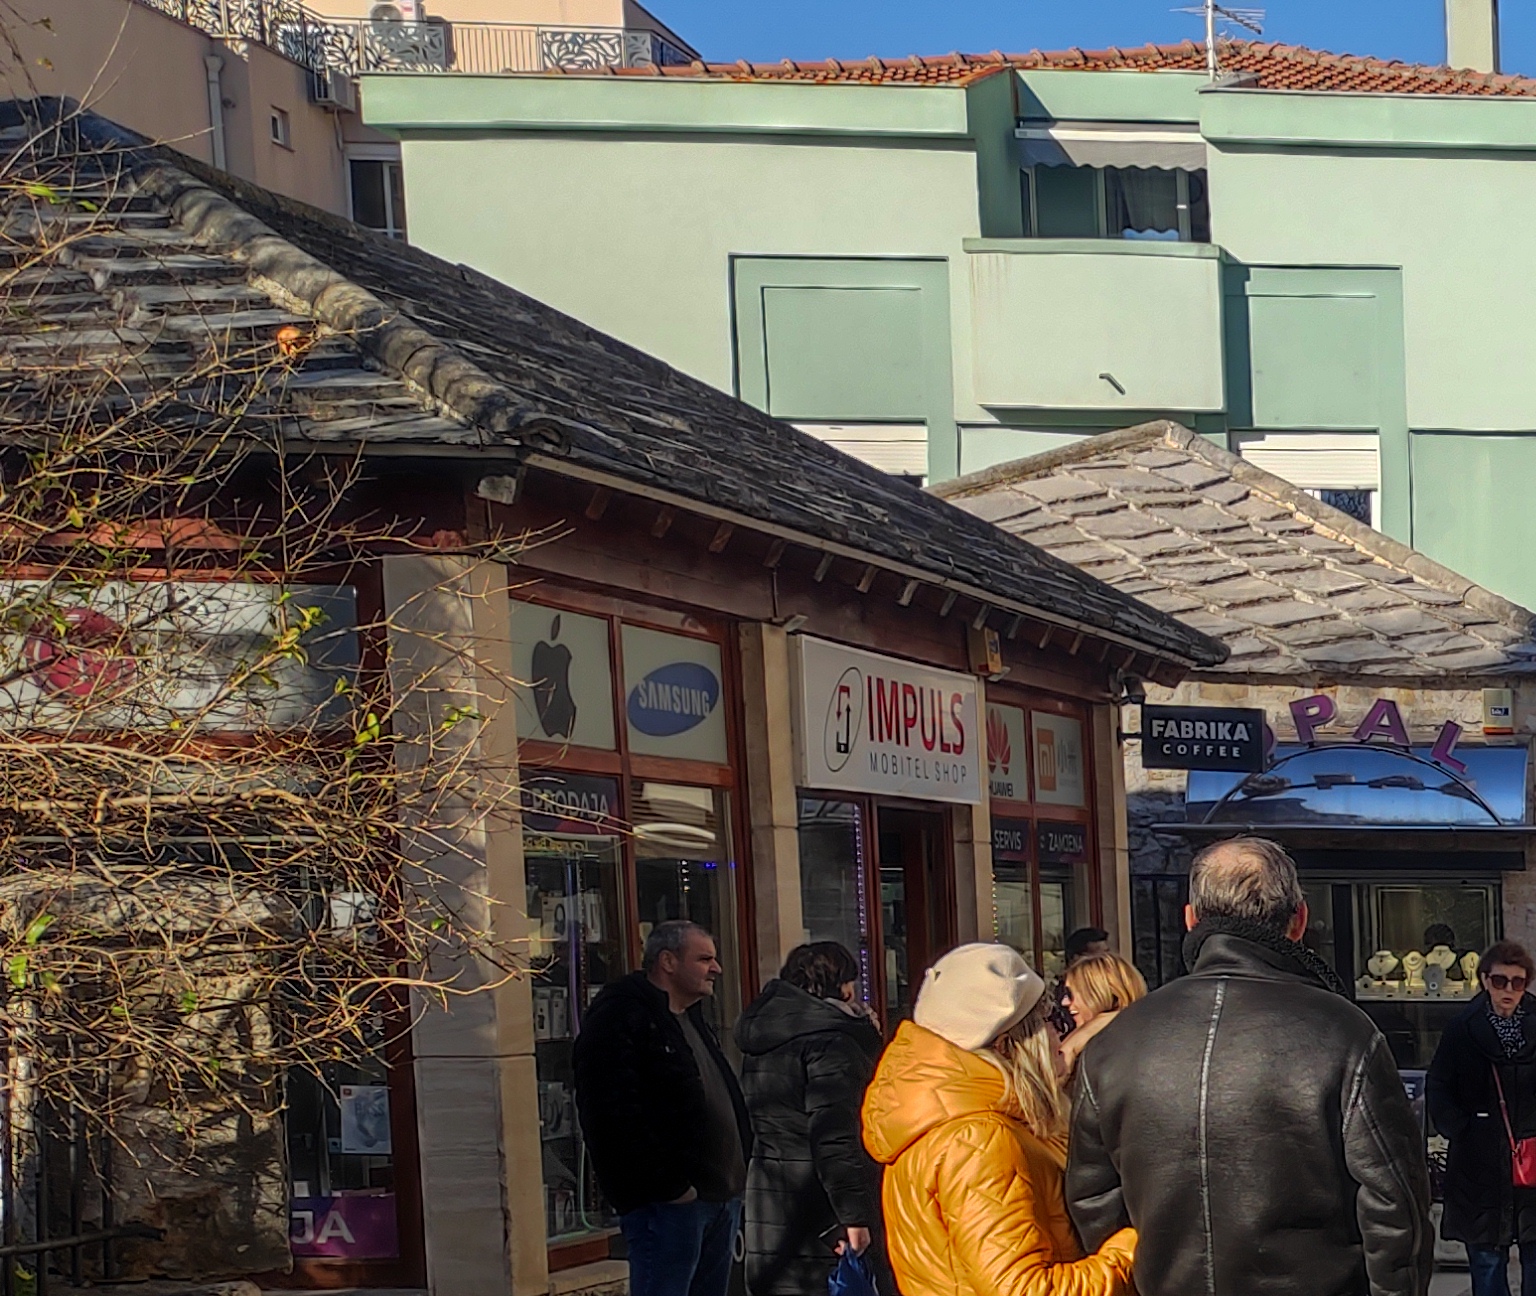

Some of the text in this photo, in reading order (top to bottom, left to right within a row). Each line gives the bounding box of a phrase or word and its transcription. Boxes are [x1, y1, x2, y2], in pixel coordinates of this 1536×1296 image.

[638, 680, 711, 717] SAMSUNG
[867, 675, 965, 756] IMPULS
[1152, 719, 1250, 742] FABRIKA
[1163, 744, 1241, 759] COFFEE
[870, 752, 968, 784] MOBITEL SHOP
[993, 830, 1022, 850] SERVIS
